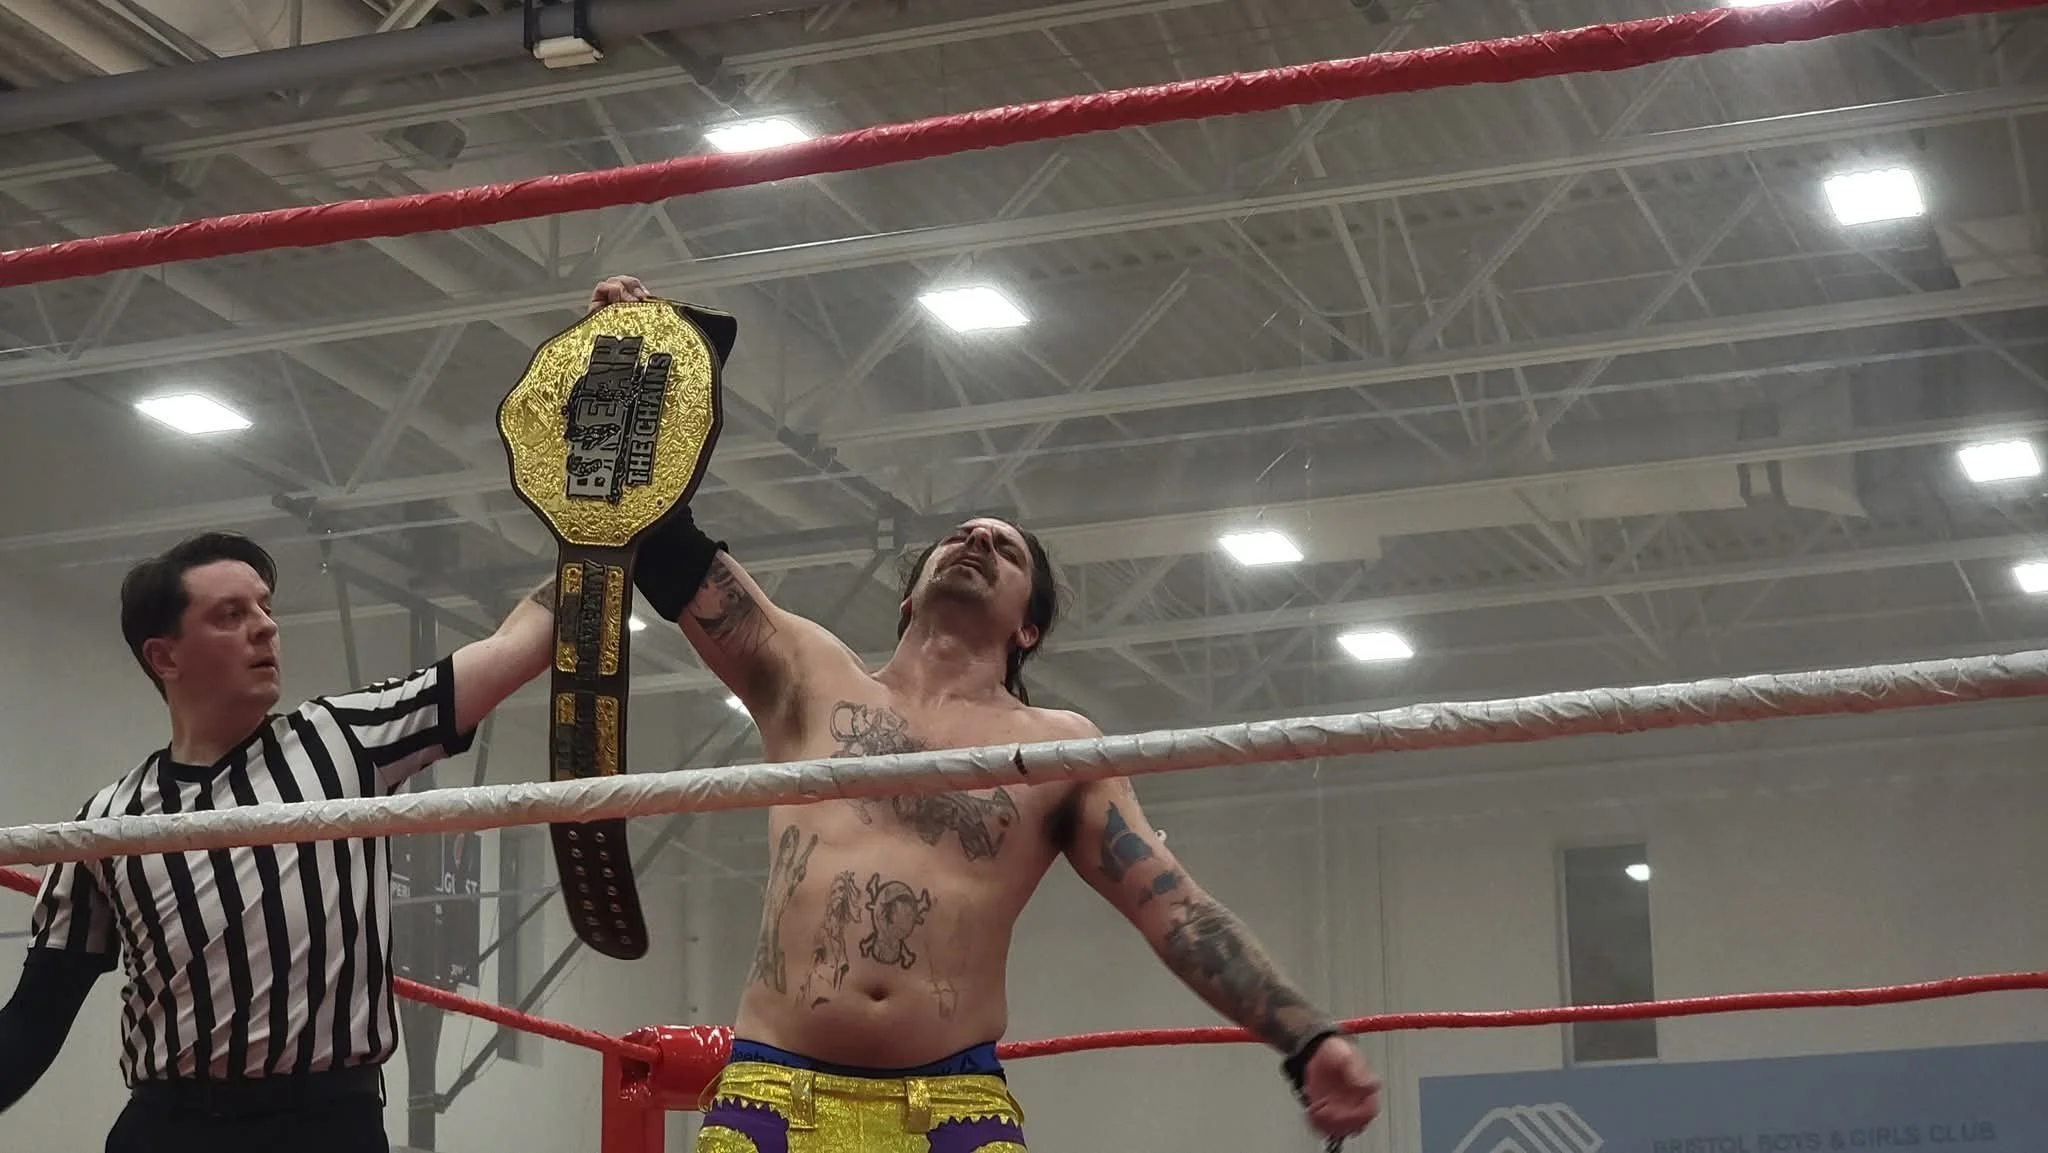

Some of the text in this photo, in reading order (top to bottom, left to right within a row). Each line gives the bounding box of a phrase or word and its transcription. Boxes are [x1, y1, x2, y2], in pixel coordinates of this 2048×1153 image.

[567, 335, 644, 500] BREAK
[626, 353, 672, 487] THE CHAINS
[1652, 1120, 1997, 1153] BRISTOL BOYS & GIRLS CLUB
